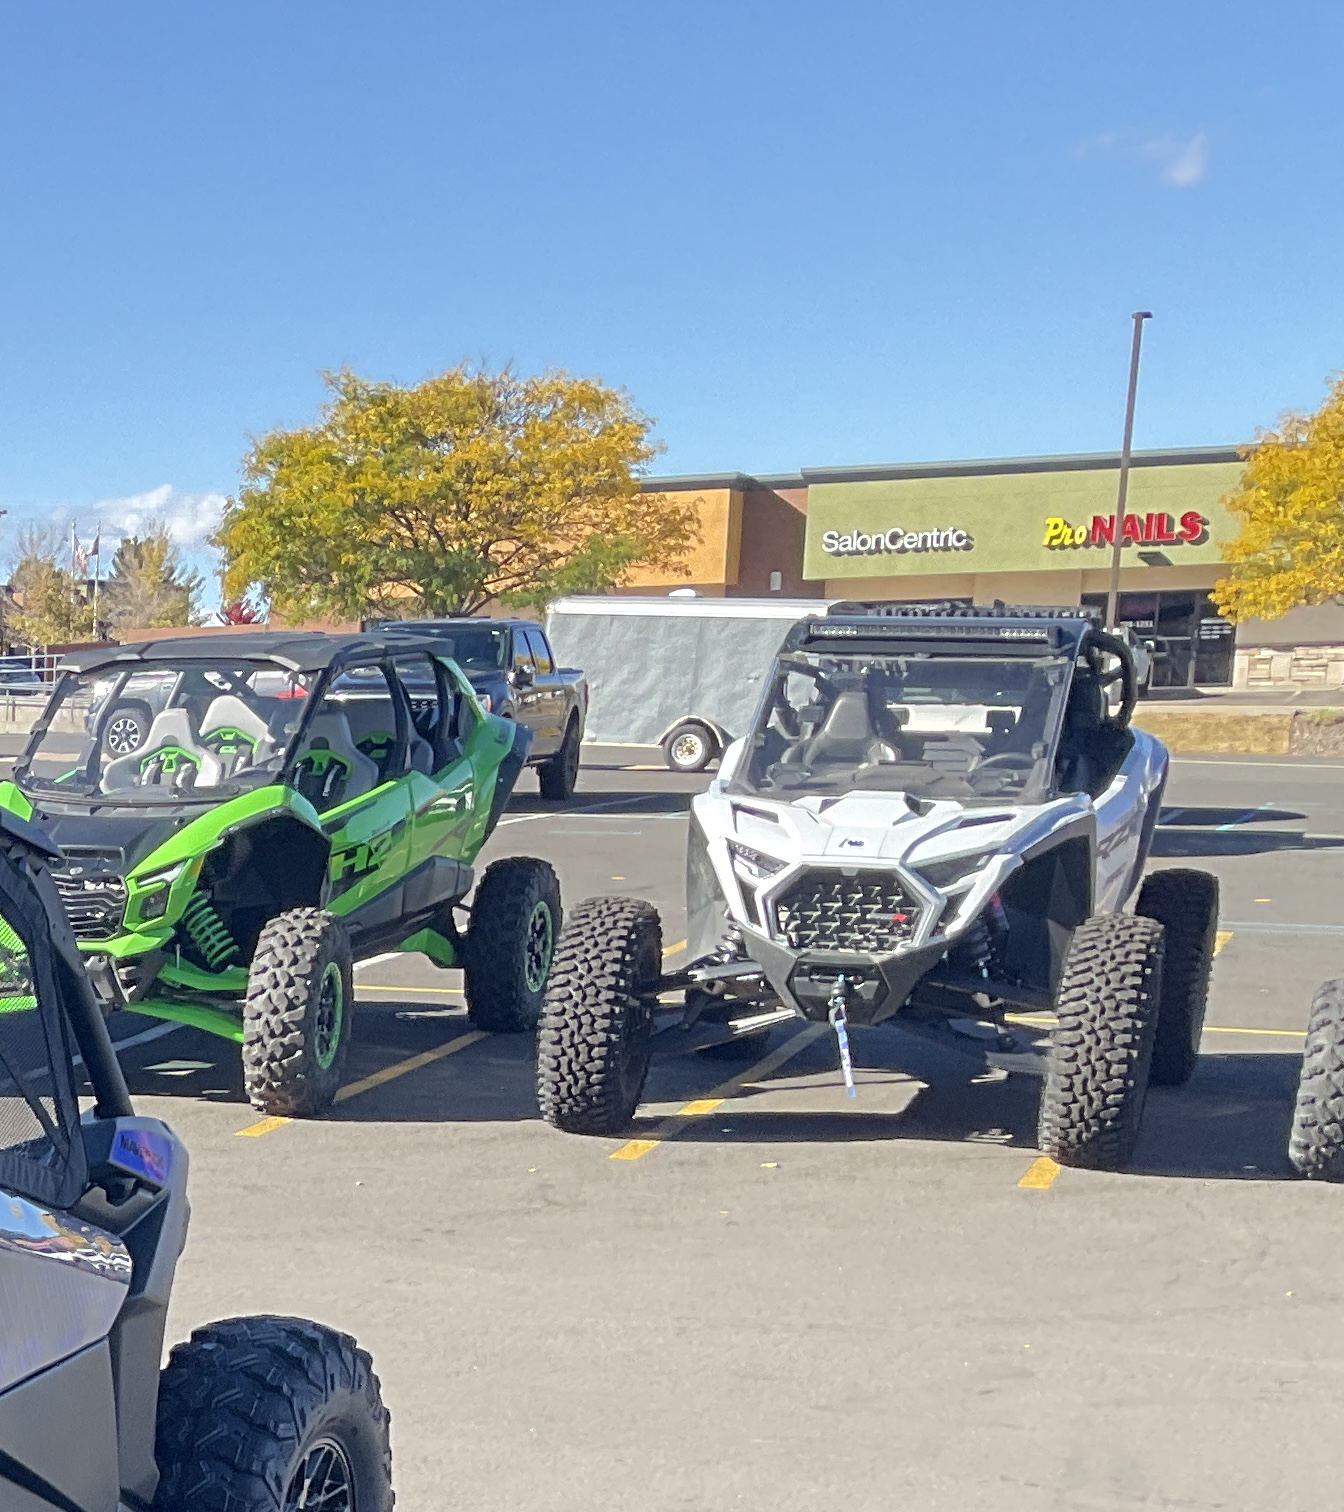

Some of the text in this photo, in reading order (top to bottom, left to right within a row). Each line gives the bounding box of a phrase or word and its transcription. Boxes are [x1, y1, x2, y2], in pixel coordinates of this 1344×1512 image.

[821, 527, 967, 552] SalonCentric
[1042, 511, 1204, 546] Pro NAILS
